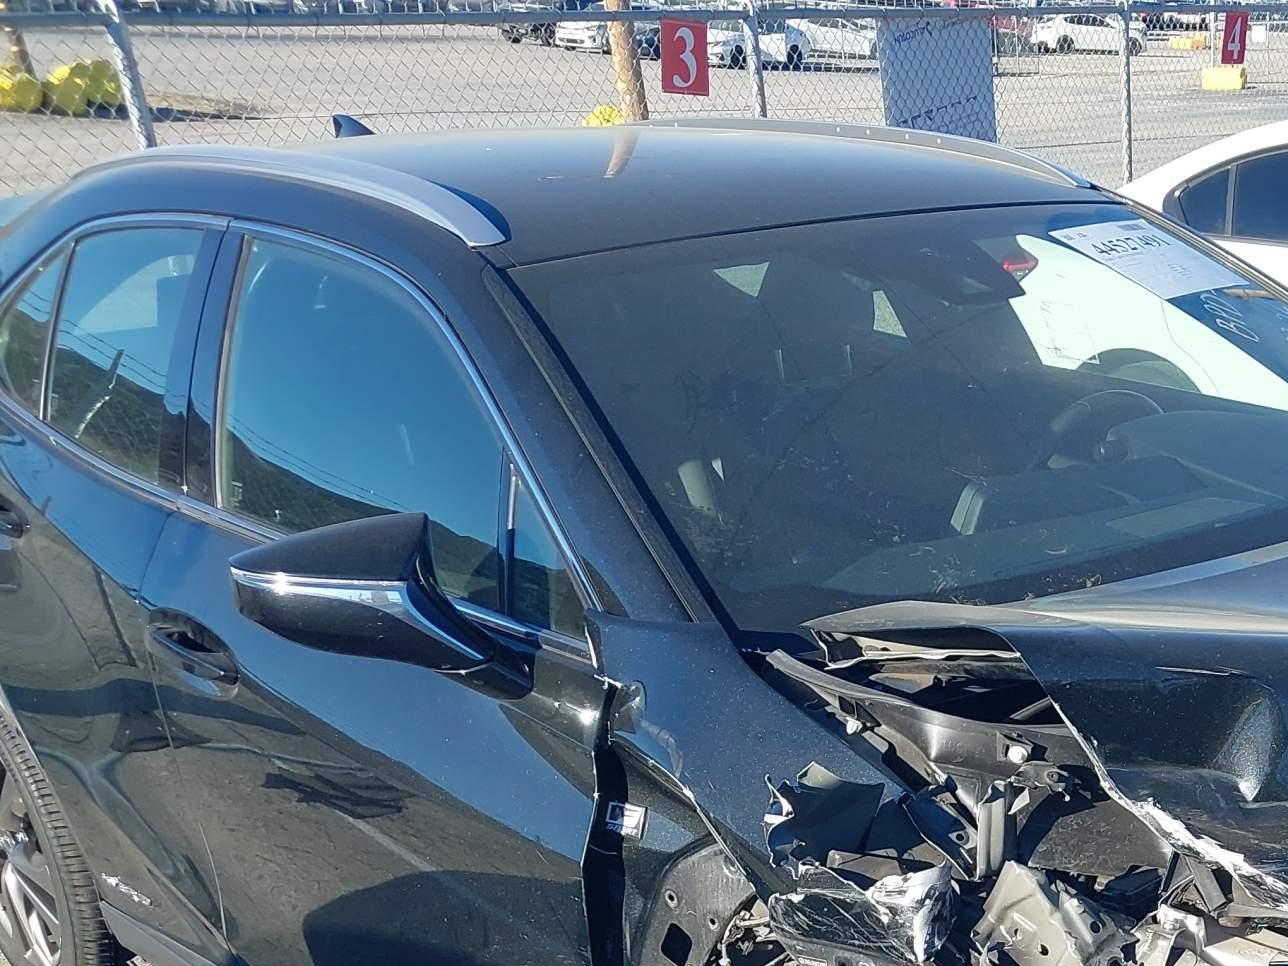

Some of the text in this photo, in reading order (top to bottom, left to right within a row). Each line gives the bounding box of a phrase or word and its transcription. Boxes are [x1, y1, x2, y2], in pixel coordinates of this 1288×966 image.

[673, 27, 697, 88] 3
[1227, 16, 1242, 60] 4
[1091, 234, 1171, 256] 44527491
